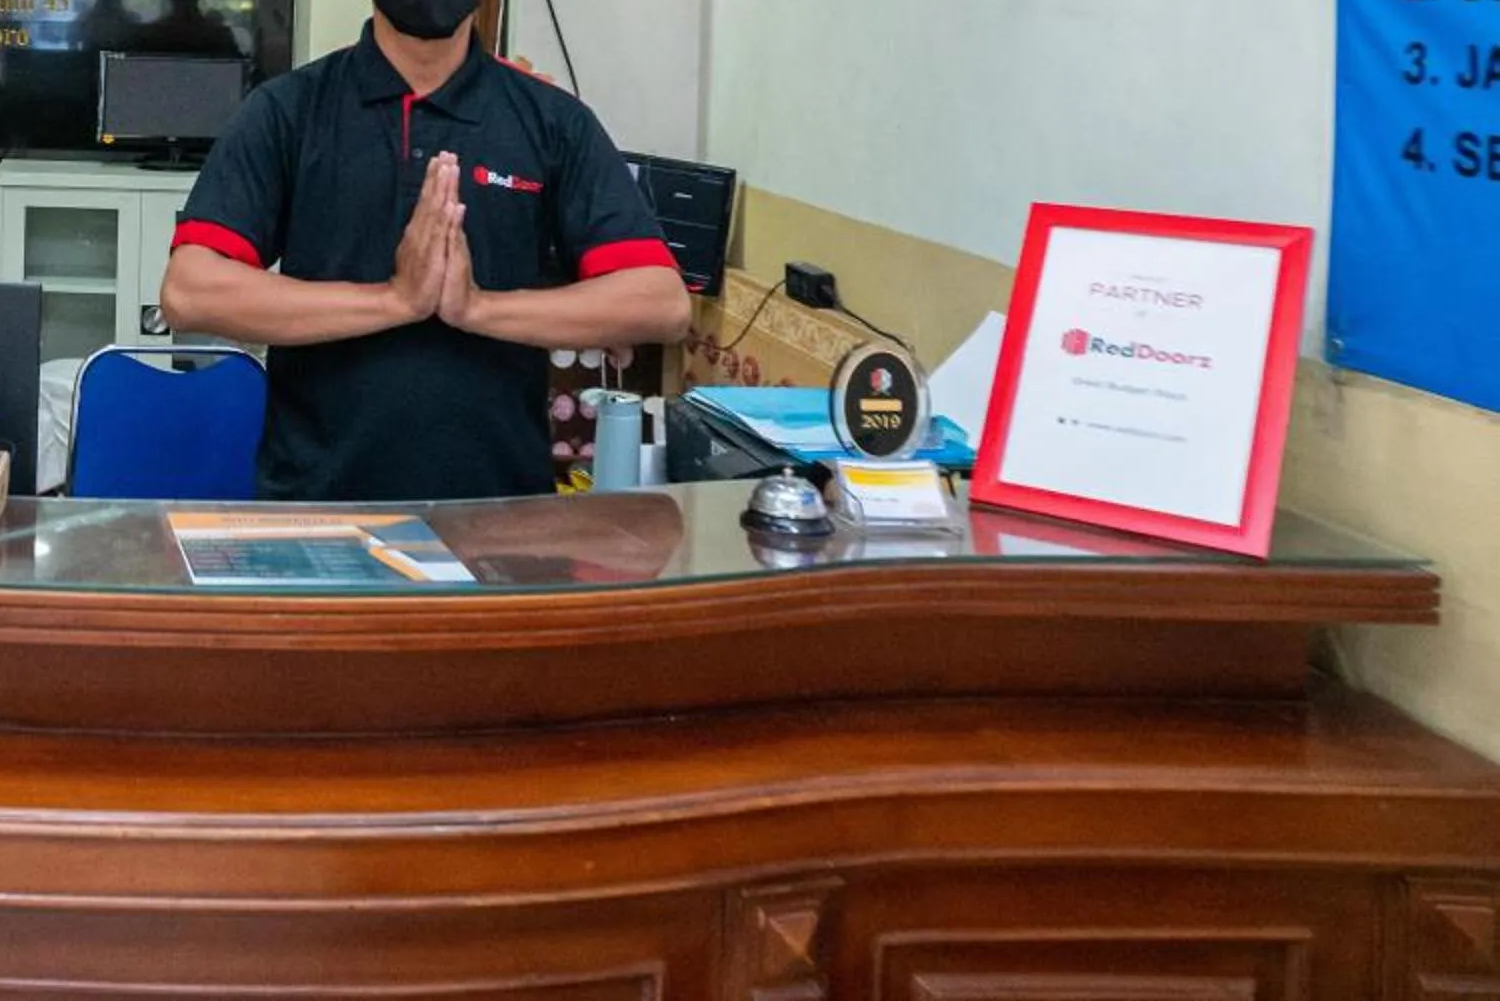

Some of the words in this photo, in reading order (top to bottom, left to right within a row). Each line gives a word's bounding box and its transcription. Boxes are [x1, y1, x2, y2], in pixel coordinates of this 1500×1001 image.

[1403, 41, 1441, 85] 3.
[1402, 128, 1436, 172] 4.
[1090, 281, 1202, 309] PARTNER
[1090, 336, 1213, 369] RedDoorz
